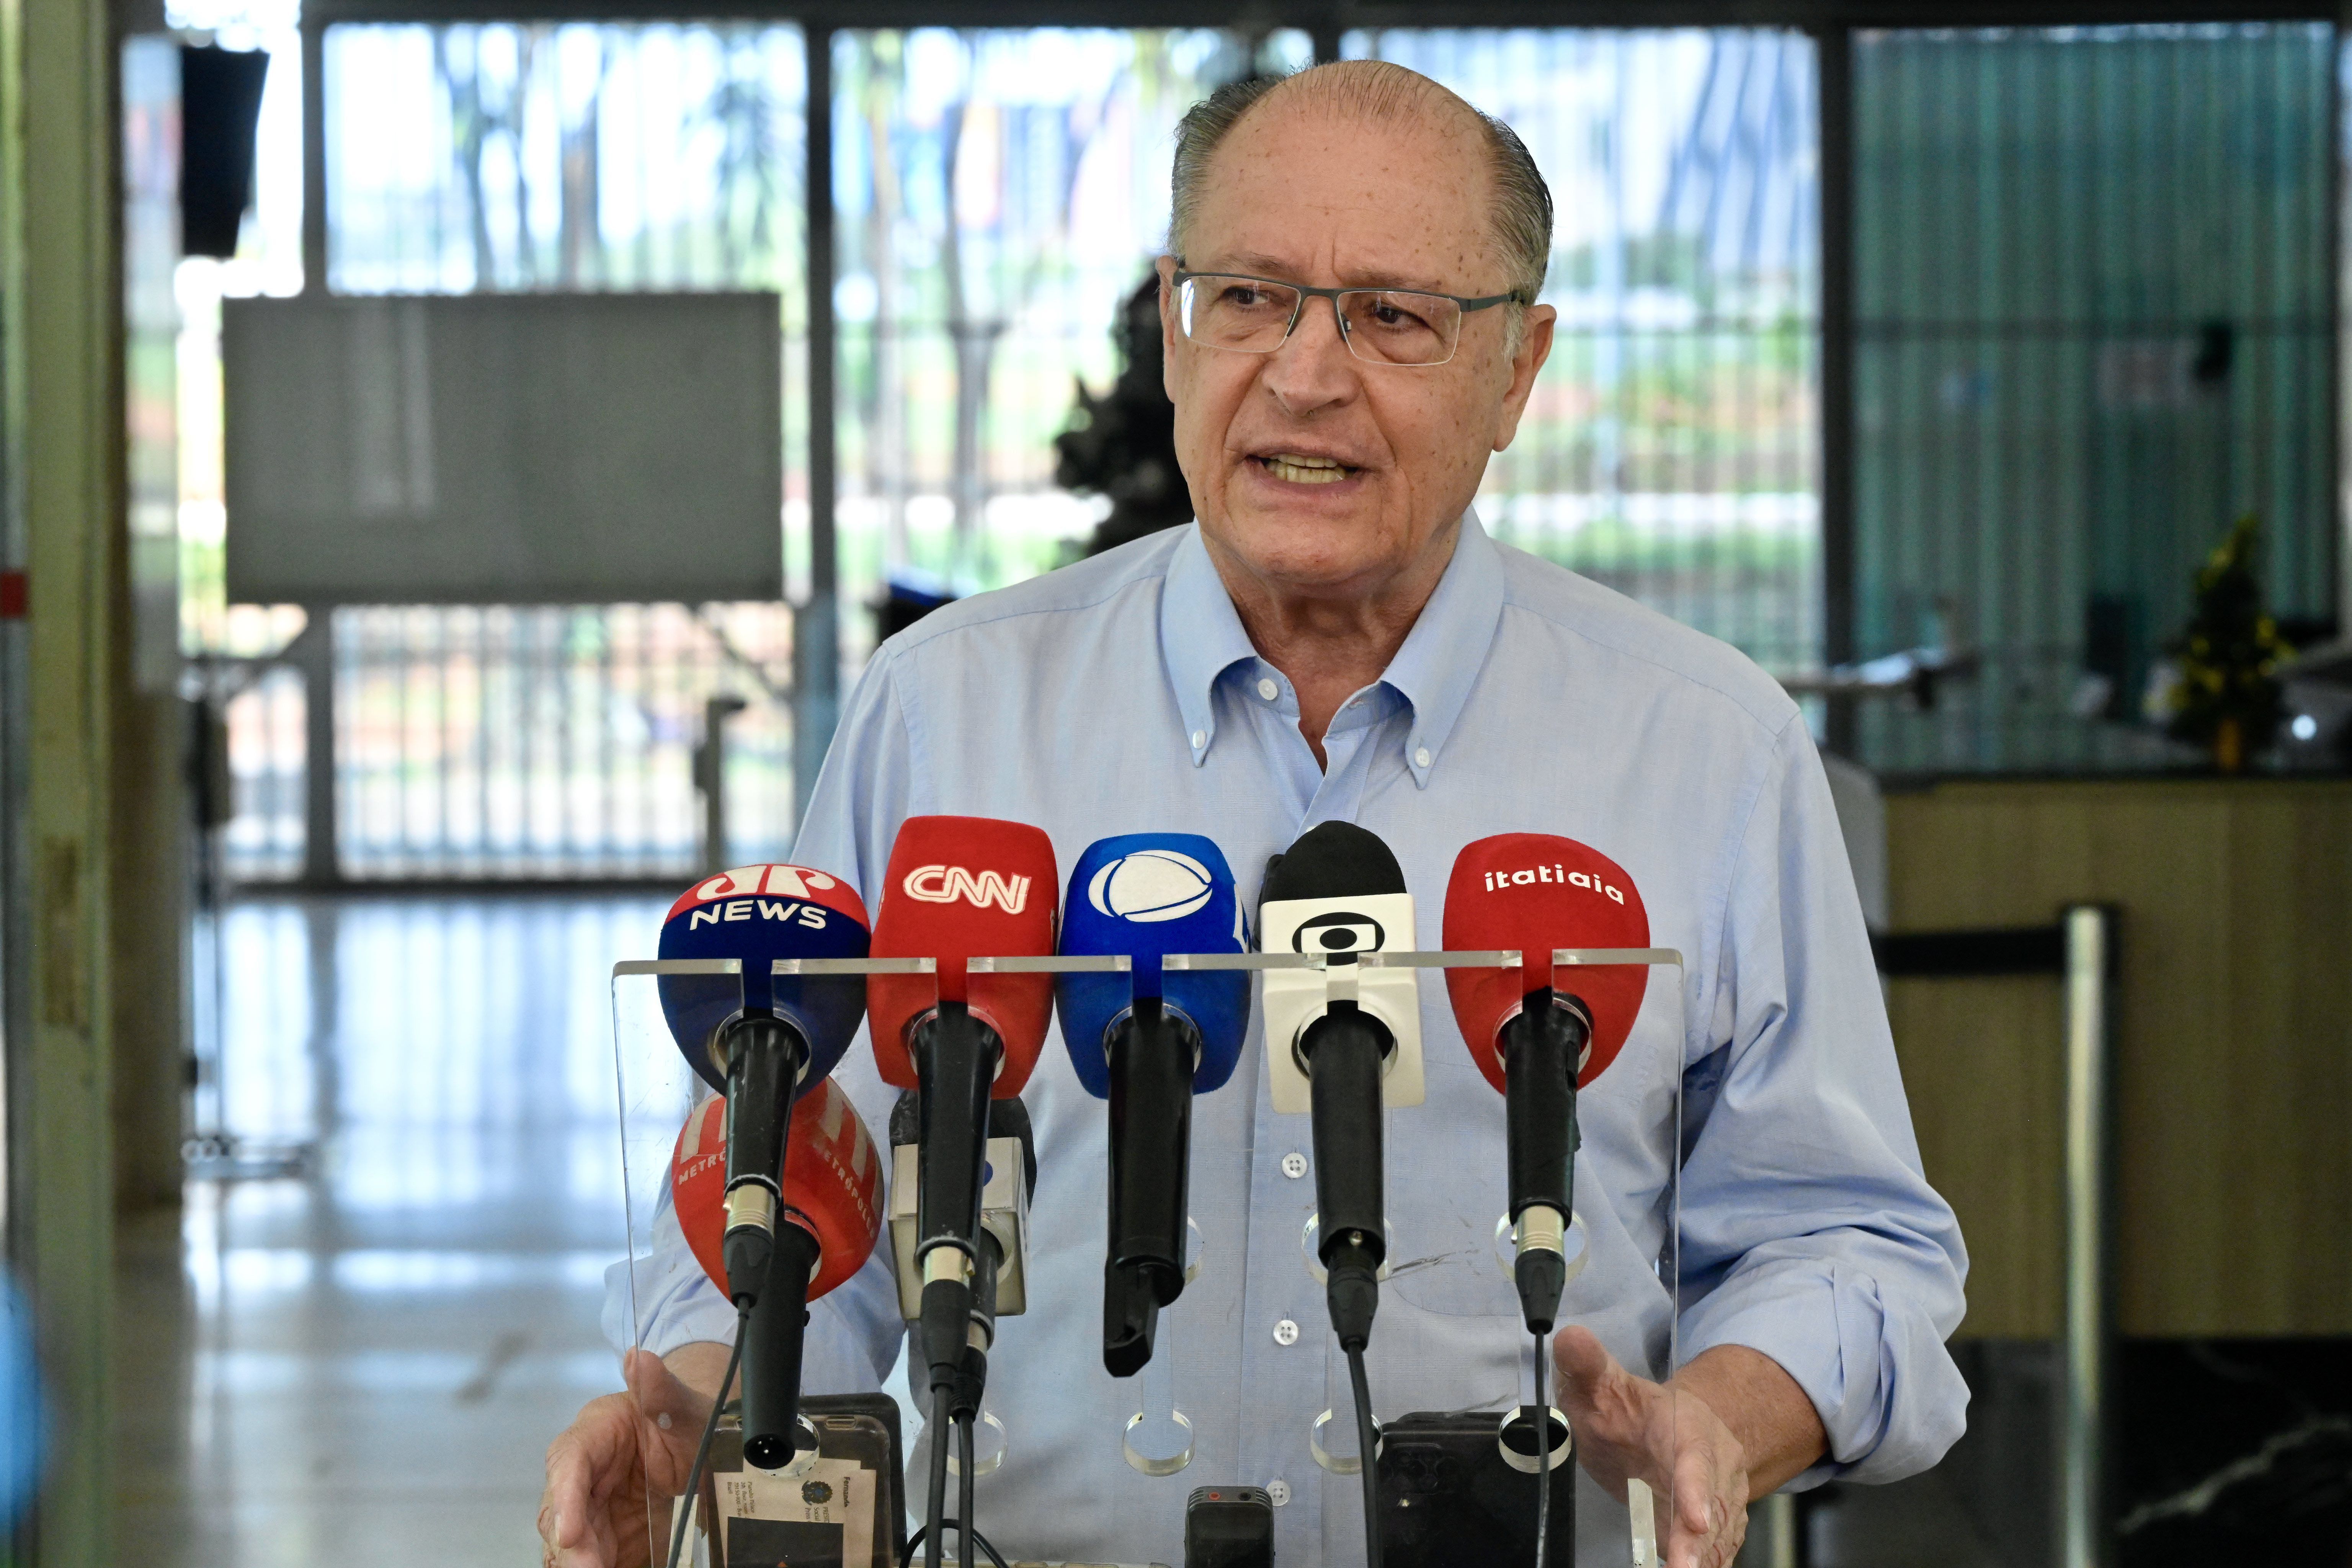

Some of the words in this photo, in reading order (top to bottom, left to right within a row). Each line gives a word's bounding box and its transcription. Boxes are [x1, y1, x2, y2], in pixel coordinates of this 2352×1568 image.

[903, 864, 1032, 915] CNN
[1485, 864, 1624, 905] itatiaia
[689, 900, 826, 931] NEWS
